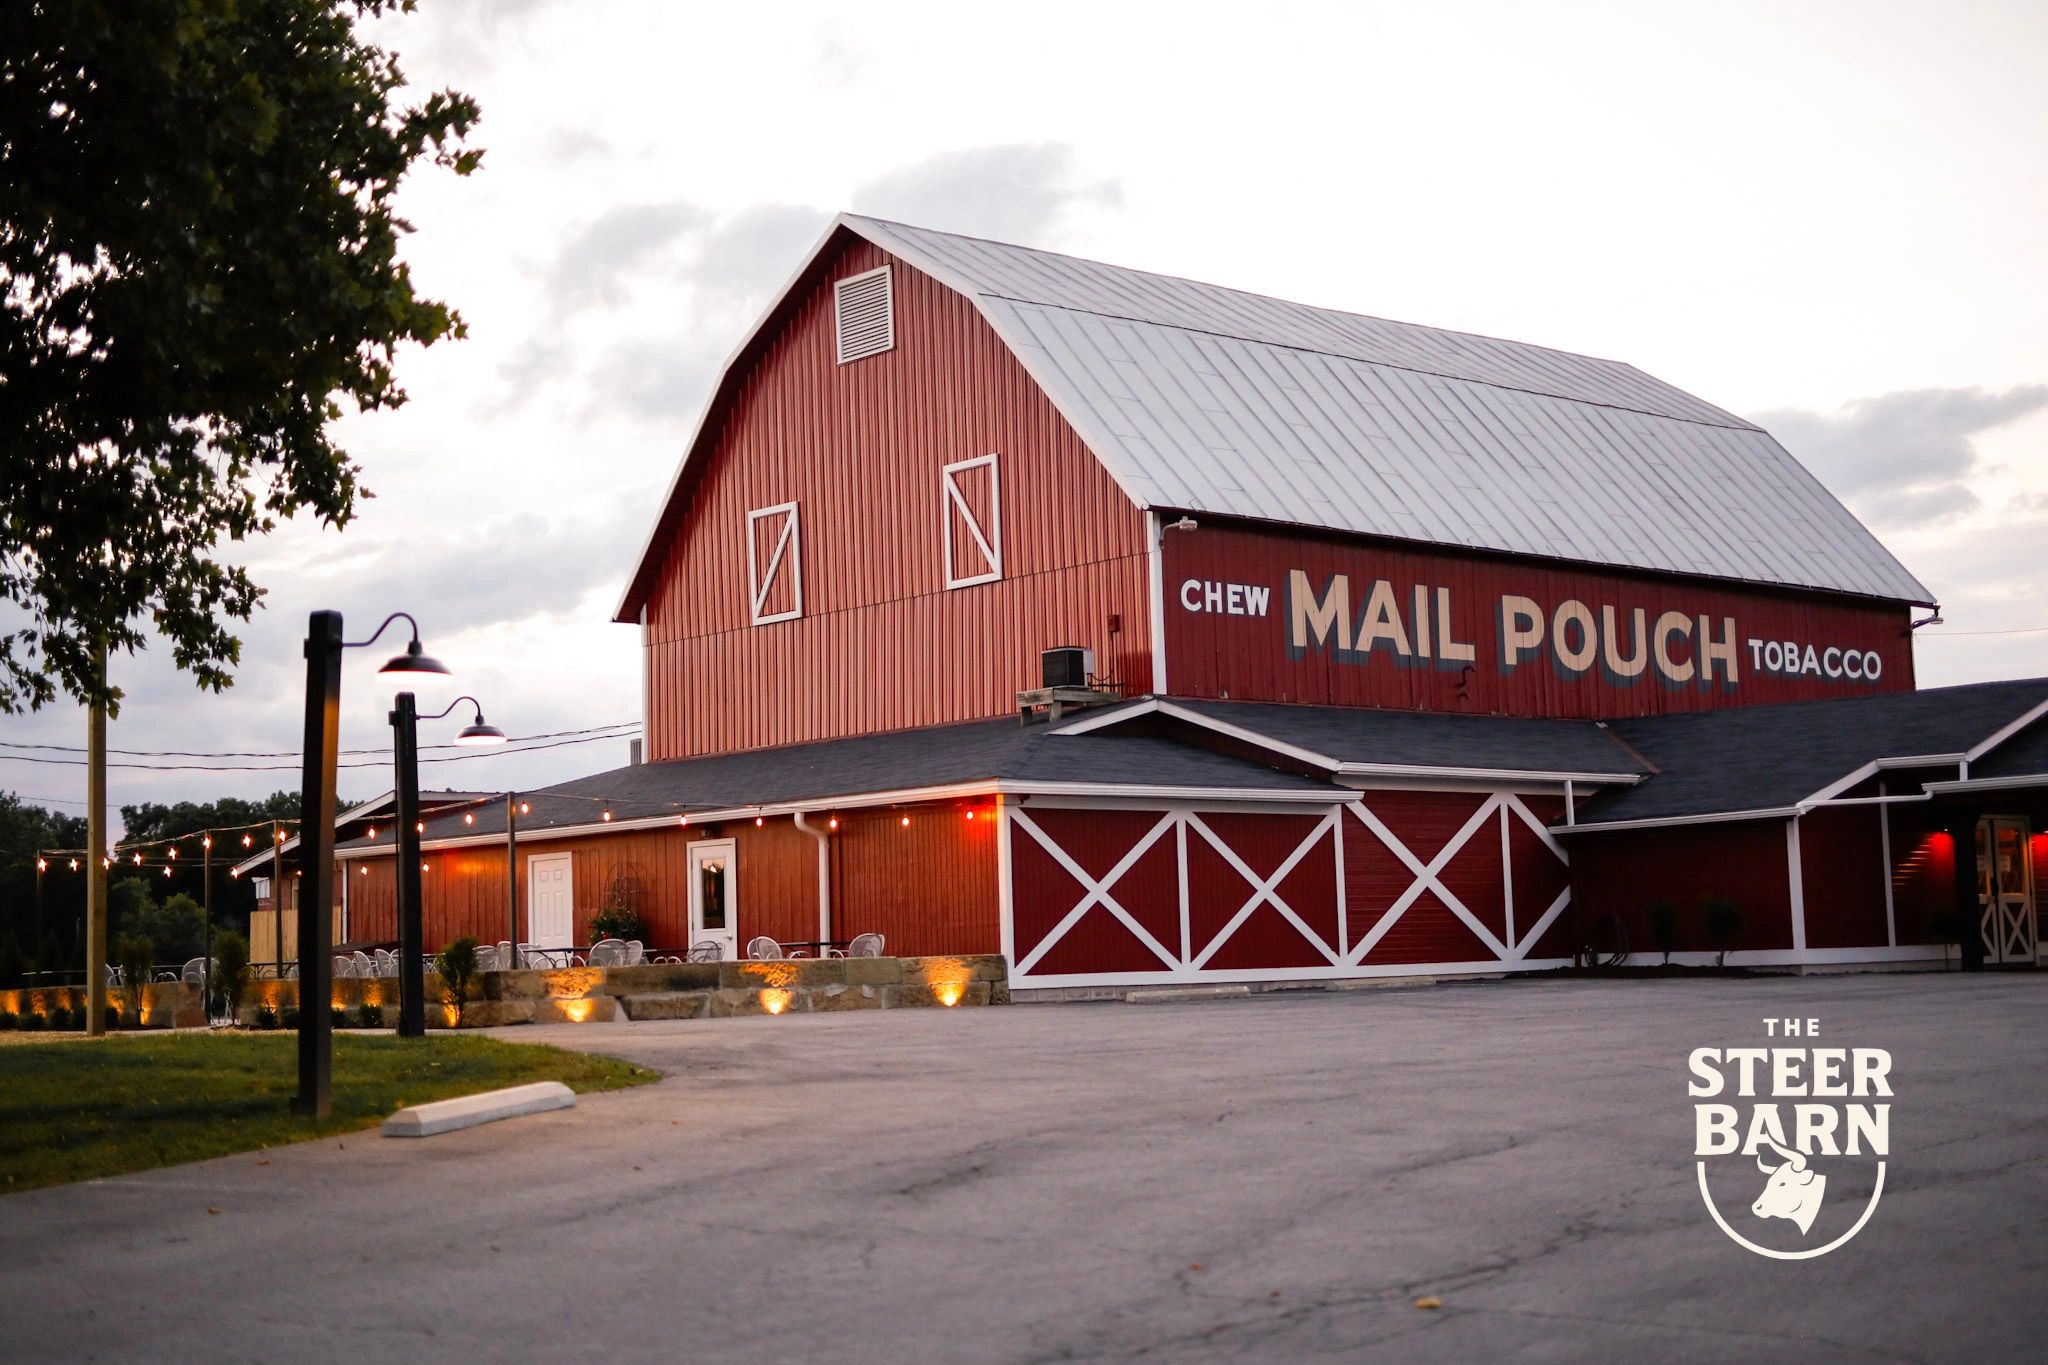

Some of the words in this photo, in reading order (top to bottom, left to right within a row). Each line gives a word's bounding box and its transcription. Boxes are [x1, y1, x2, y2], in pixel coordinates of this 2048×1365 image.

[1180, 579, 1270, 617] CHEW
[1289, 569, 1476, 662] MAIL
[1501, 595, 1739, 683] POUCH
[1748, 639, 1882, 681] TOBACCO
